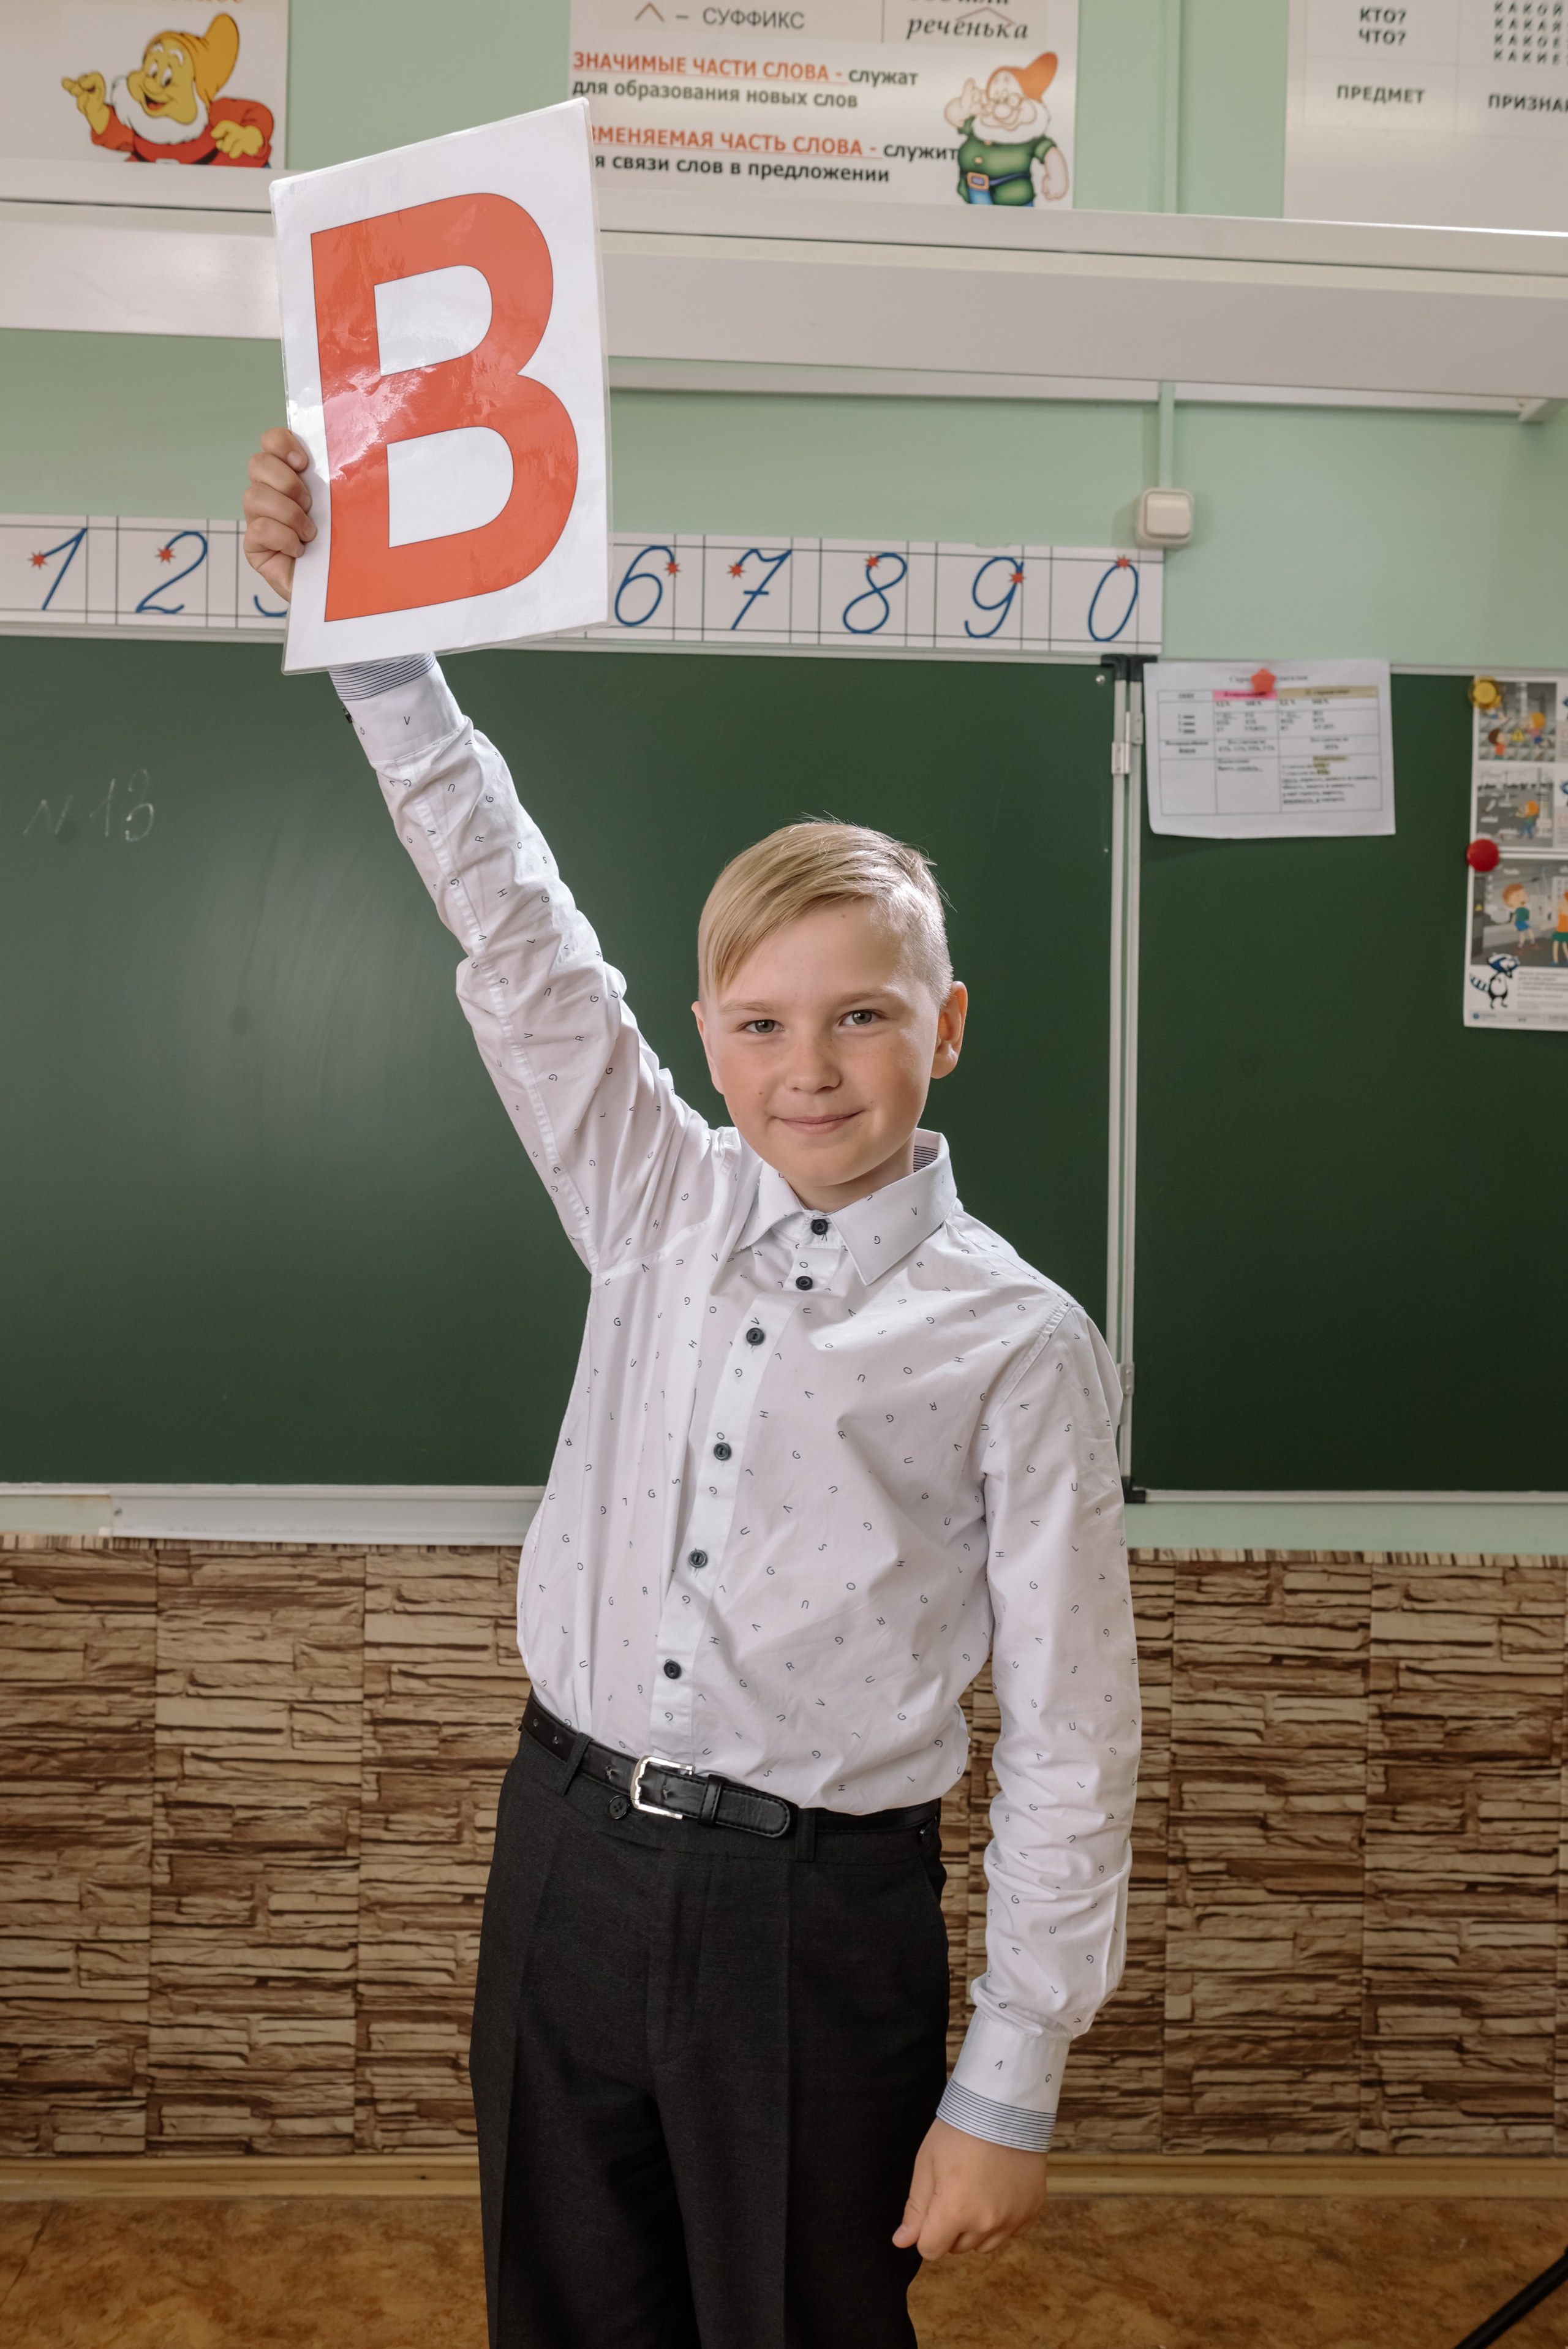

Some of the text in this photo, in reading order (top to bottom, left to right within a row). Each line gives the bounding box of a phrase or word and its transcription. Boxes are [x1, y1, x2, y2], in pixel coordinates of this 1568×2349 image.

[702, 7, 805, 29] СУФФИКС
[1359, 7, 1407, 25] КТО?
[906, 16, 1029, 41] реченька
[1358, 28, 1407, 46] ЧТО?
[573, 51, 687, 74] ЗНАЧИМЫЕ
[693, 58, 757, 77] ЧАСТИ
[763, 61, 829, 81] СЛОВА
[848, 69, 918, 88] служат
[573, 79, 858, 108] для образования новых слов
[1336, 85, 1426, 105] ПРЕДМЕТ
[720, 132, 786, 152] ЧАСТЬ
[793, 136, 863, 156] СЛОВА
[883, 144, 959, 162] служит
[612, 156, 669, 172] связи
[676, 159, 723, 175] слов
[730, 162, 741, 175] в
[748, 163, 889, 183] предложении
[310, 192, 579, 622] В
[39, 527, 1139, 643] 1 2 6 7 8 9 0
[497, 888, 508, 898] H
[652, 1219, 660, 1229] H
[688, 1340, 698, 1349] H
[759, 1410, 769, 1419] H
[929, 1401, 938, 1411] R
[564, 1438, 573, 1447] R
[837, 1430, 846, 1439] R
[642, 1586, 648, 1596] R
[876, 1616, 886, 1626] R
[785, 1662, 795, 1671] R
